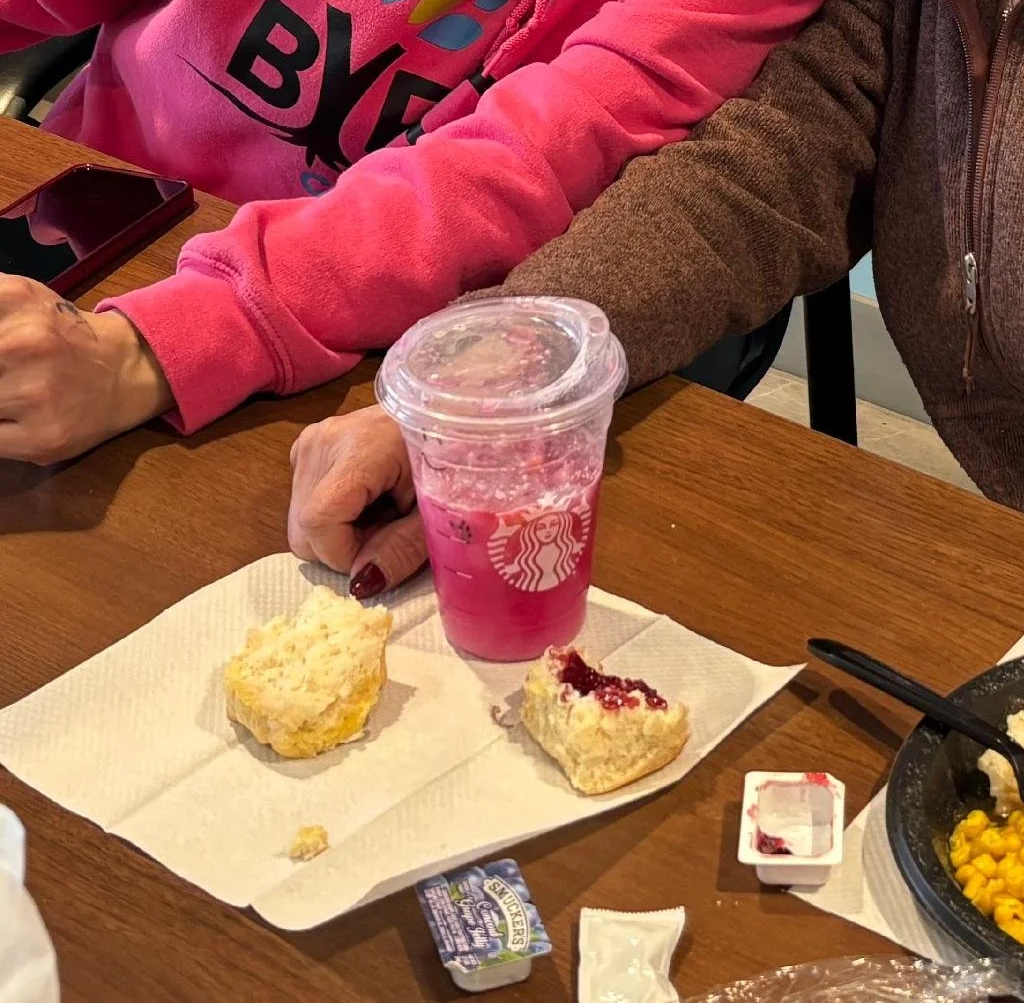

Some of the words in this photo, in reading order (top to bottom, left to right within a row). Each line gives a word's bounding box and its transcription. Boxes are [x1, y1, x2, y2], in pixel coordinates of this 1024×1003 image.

[455, 896, 477, 930] Grape
[467, 927, 490, 949] Jelly
[476, 900, 504, 938] Concord
[488, 881, 525, 947] SMUCKER'S
